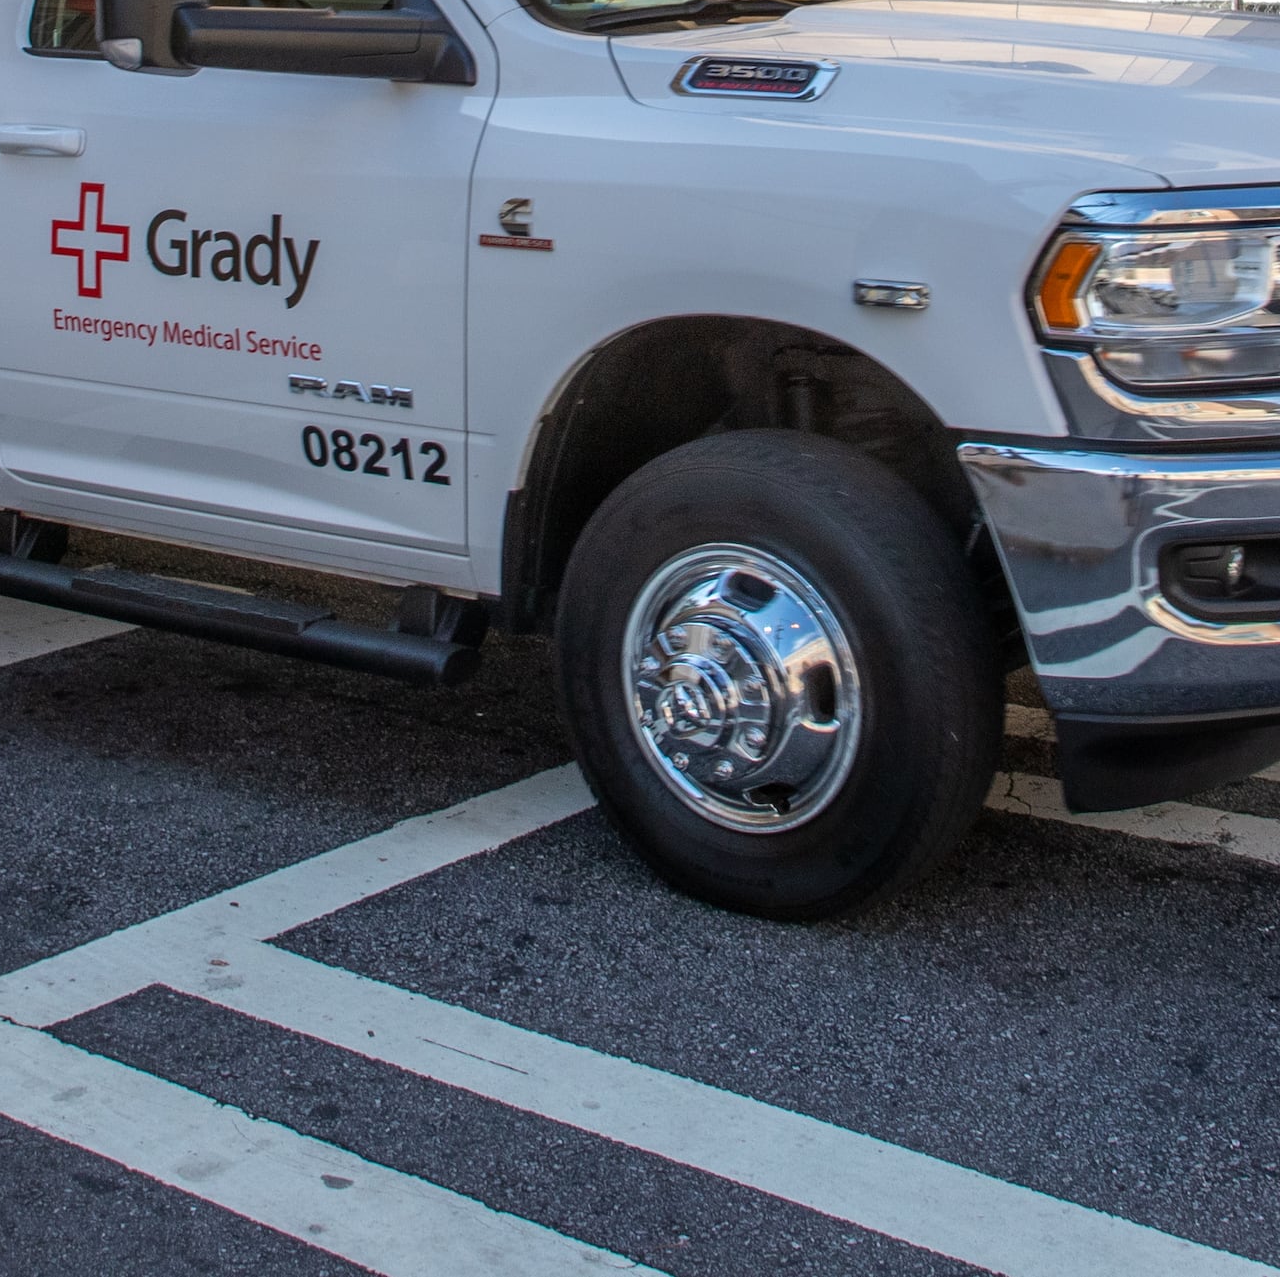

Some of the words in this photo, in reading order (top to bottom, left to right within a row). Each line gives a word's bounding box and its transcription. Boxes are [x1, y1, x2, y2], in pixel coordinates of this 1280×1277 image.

[705, 64, 810, 82] 3500
[145, 208, 320, 309] Grady
[53, 308, 158, 347] Emergency
[163, 320, 241, 352] Medical
[246, 330, 323, 362] Service
[287, 373, 414, 409] RAM
[302, 425, 452, 486] 08212
